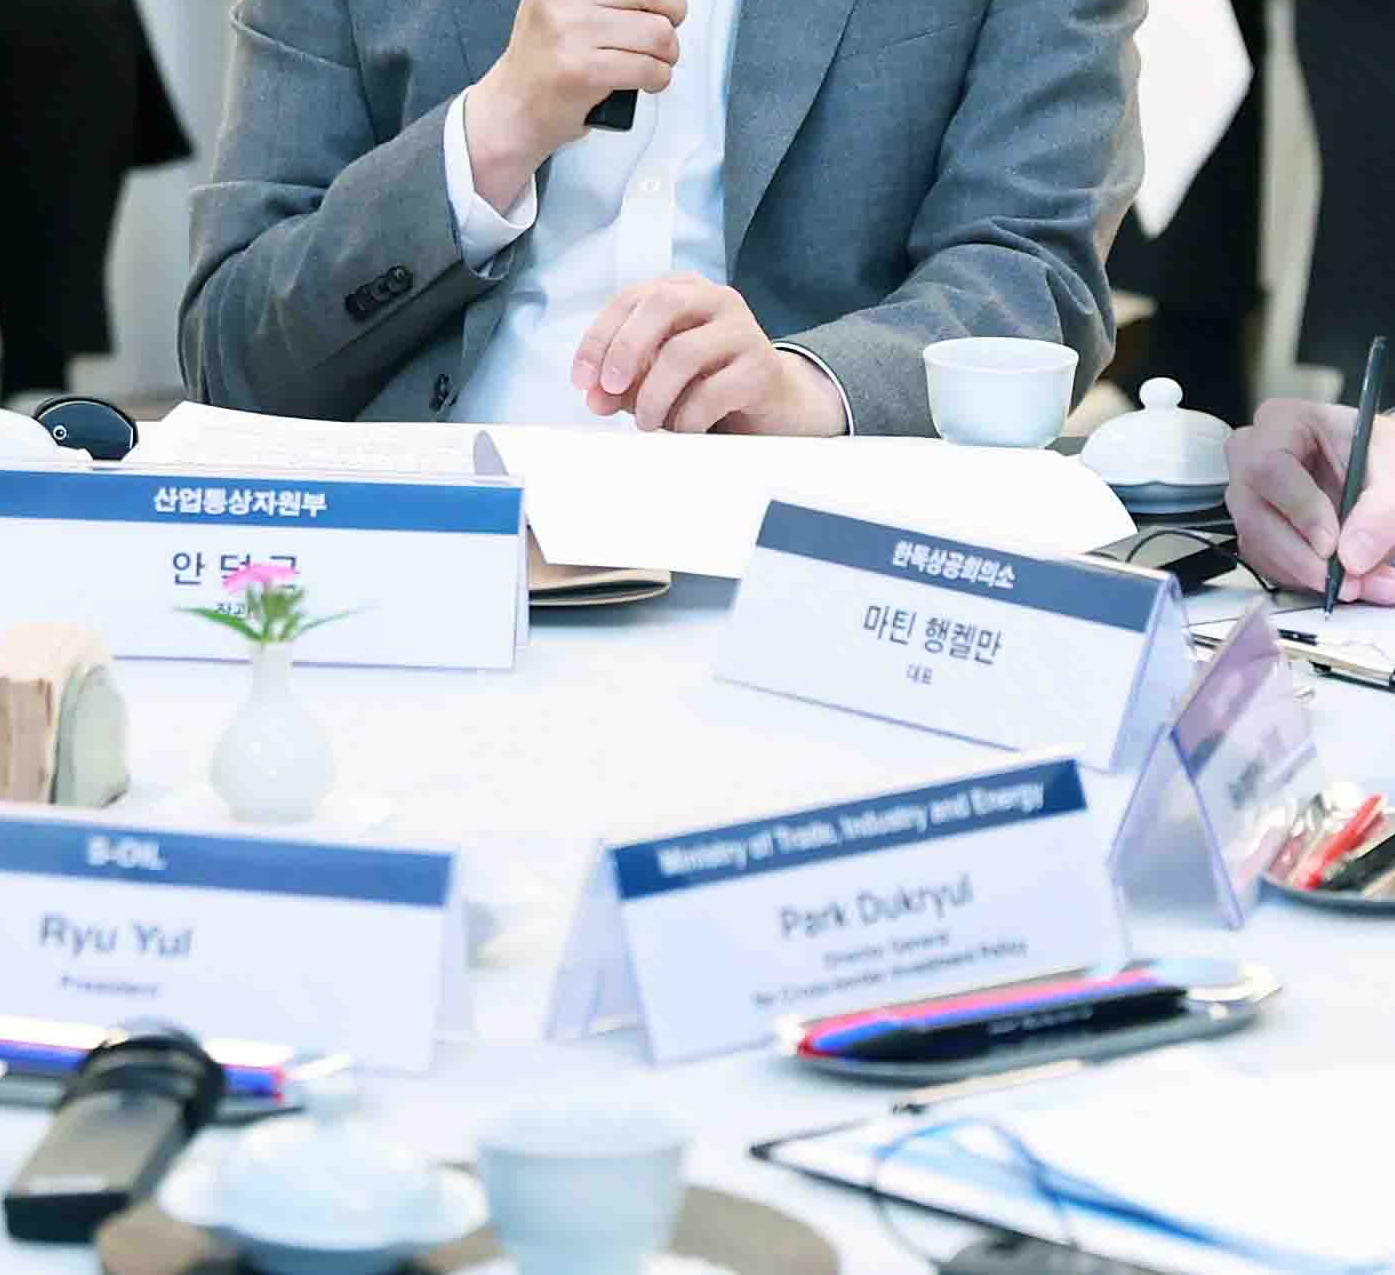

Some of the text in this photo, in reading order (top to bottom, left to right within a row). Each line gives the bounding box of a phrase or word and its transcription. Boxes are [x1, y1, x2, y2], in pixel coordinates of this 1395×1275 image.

[154, 486, 327, 518] 산업통상자원부
[863, 605, 917, 645] 마틴
[658, 838, 748, 878] Ministry
[749, 830, 773, 860] of
[840, 805, 927, 839] Industry
[929, 791, 971, 823] and
[972, 781, 1044, 814] Energy
[779, 873, 973, 938] Park Dukryul
[40, 912, 193, 958] Ryu Yul
